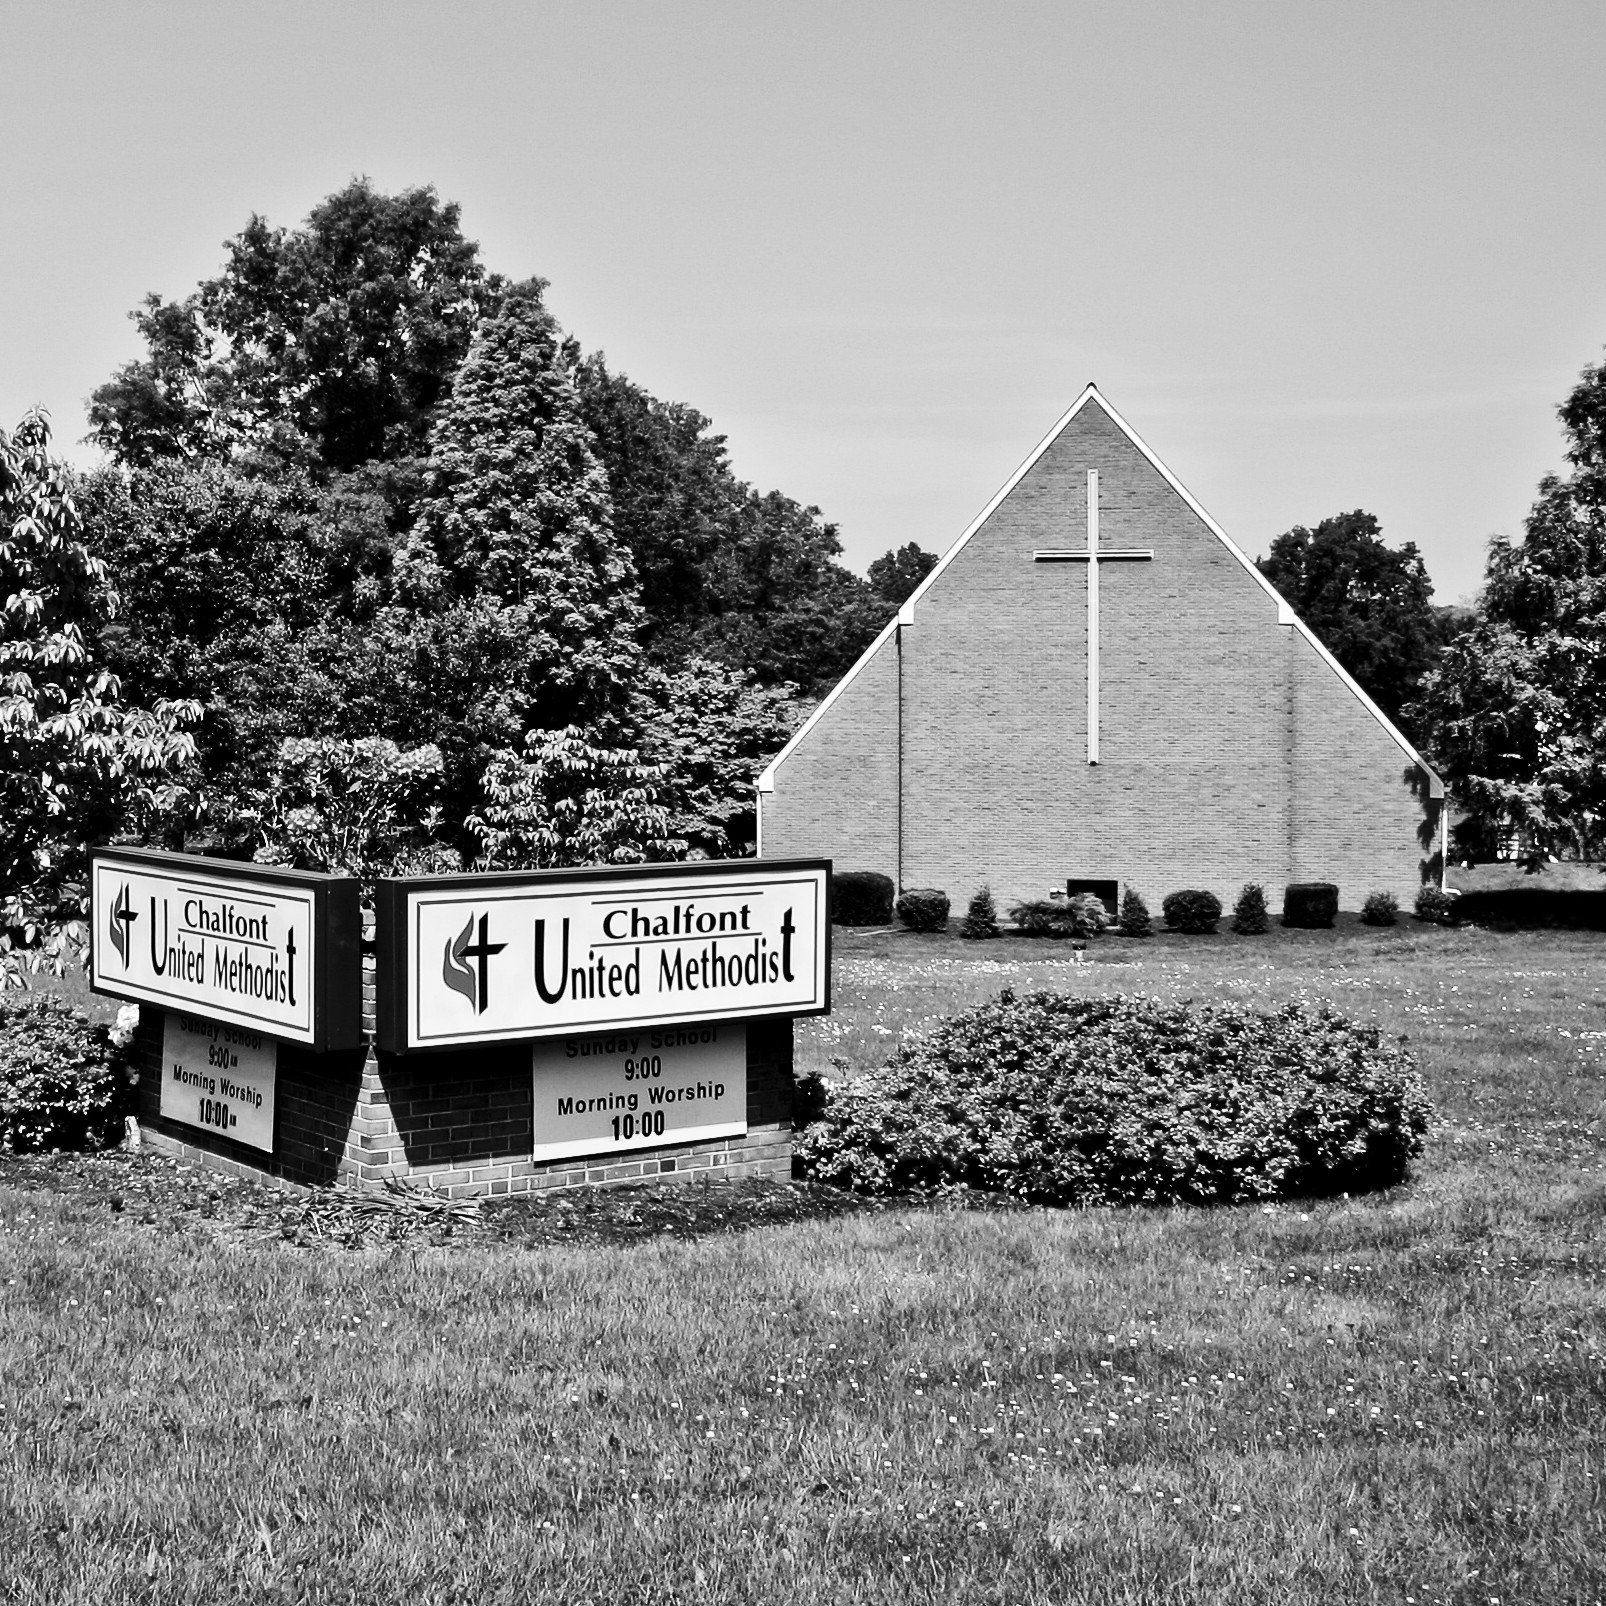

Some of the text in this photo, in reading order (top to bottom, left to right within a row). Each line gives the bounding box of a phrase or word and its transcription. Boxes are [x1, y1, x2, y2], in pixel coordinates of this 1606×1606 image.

[184, 899, 268, 942] Chalfont
[602, 903, 751, 940] Chalfont
[150, 896, 297, 1007] United Methodist
[534, 906, 796, 1005] United Methodist
[180, 1017, 219, 1042] Sunday
[565, 1025, 717, 1058] Sunday School
[624, 1055, 662, 1081] 9:00
[173, 1064, 262, 1109] Morning Worship
[557, 1081, 725, 1116] Morning Worship
[611, 1109, 665, 1141] 10:00
